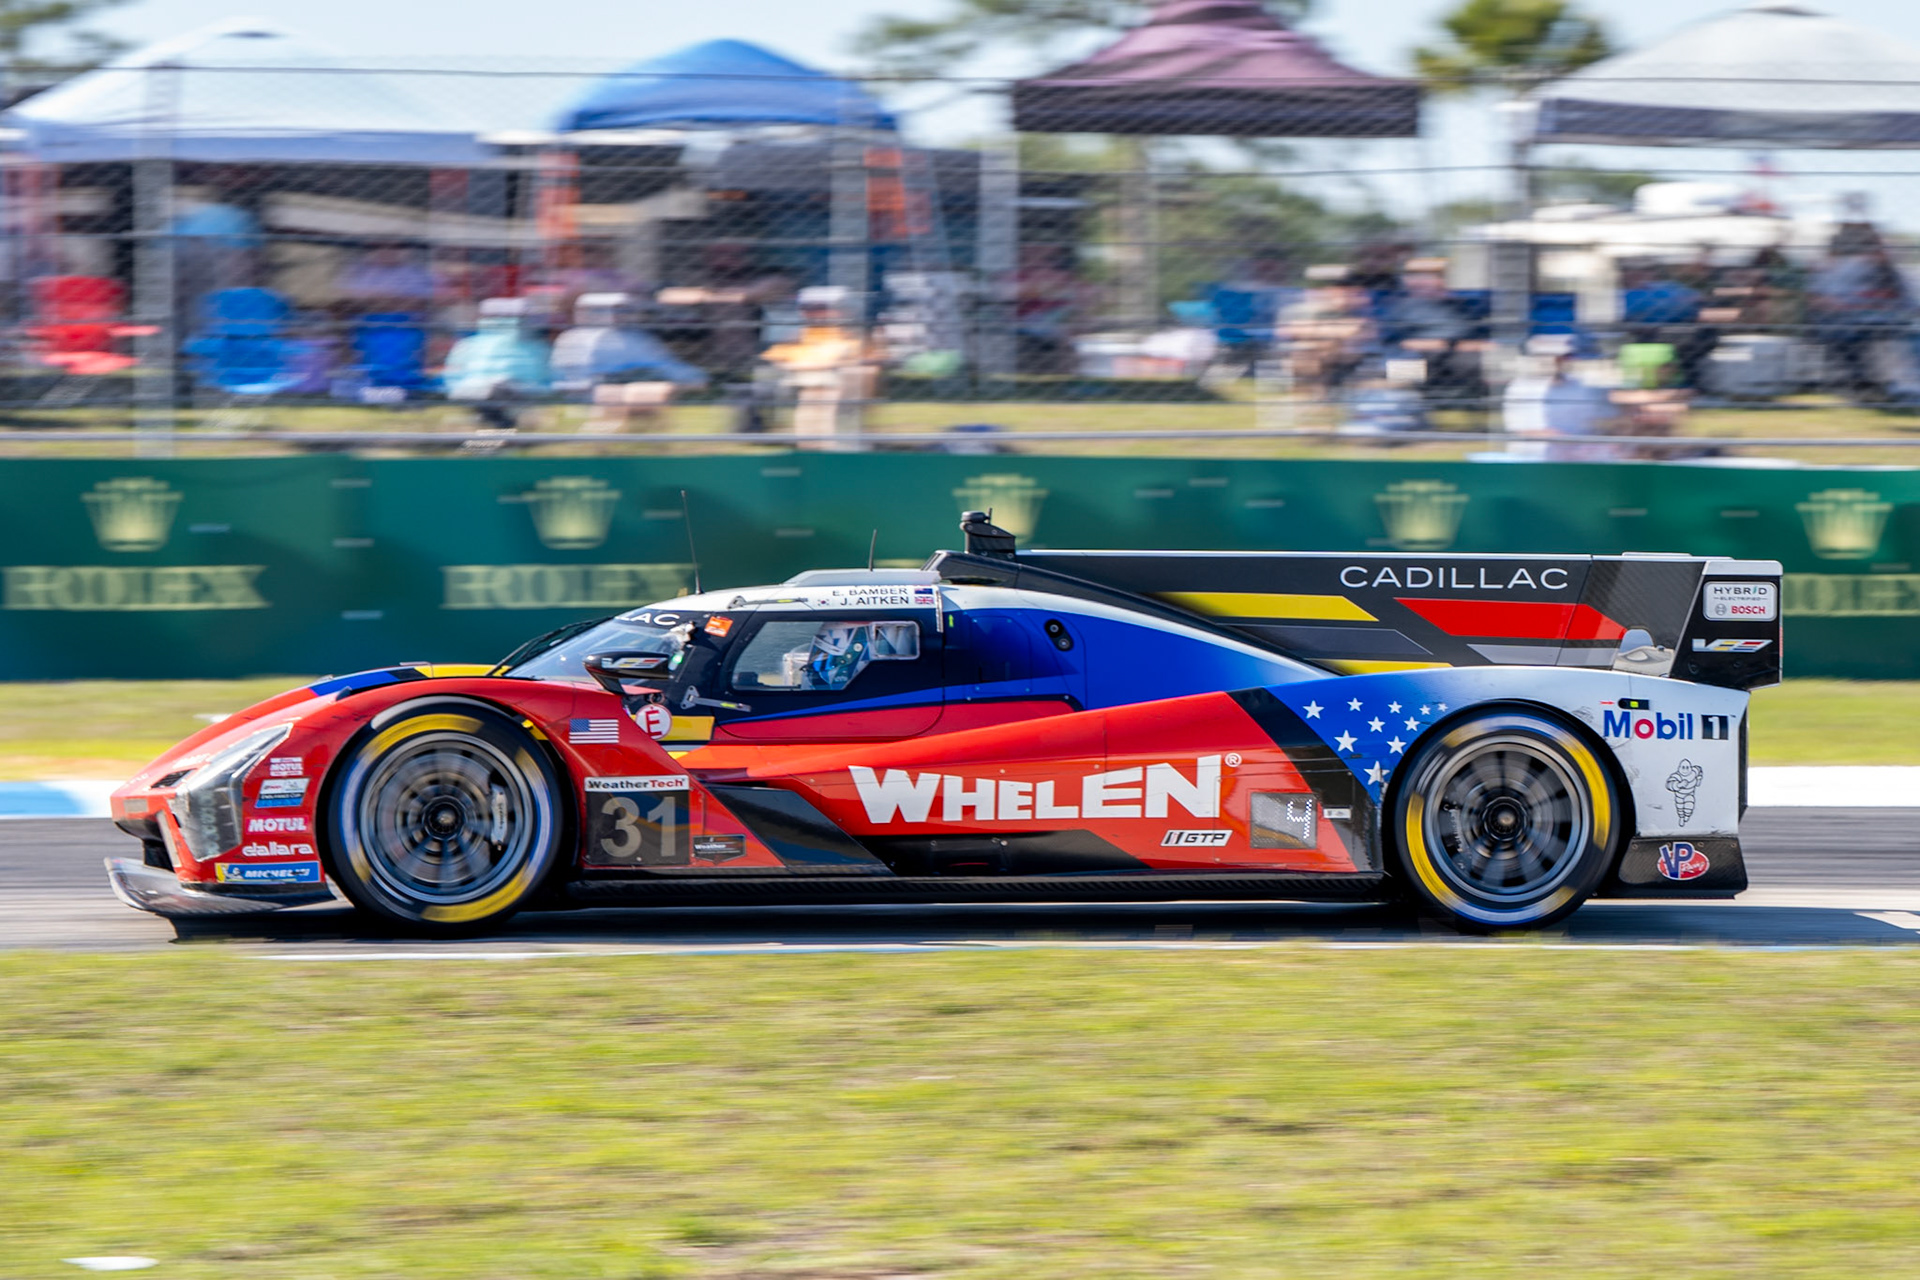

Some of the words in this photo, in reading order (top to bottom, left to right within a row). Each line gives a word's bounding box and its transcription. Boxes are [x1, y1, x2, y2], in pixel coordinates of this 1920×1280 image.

[1340, 566, 1569, 589] CADILLAC
[849, 588, 908, 596] BAMBER
[1713, 586, 1767, 595] HYBRID
[840, 598, 852, 606] J.
[856, 596, 909, 605] AITKEN
[1731, 606, 1766, 614] BOSCH
[1604, 710, 1693, 740] Mobil
[1705, 714, 1724, 740] 1
[588, 779, 686, 789] WeatherTech
[248, 817, 306, 832] MOTUL
[601, 796, 676, 858] 31
[1184, 833, 1226, 843] GTP
[242, 842, 314, 856] dallara
[1660, 842, 1695, 879] VP
